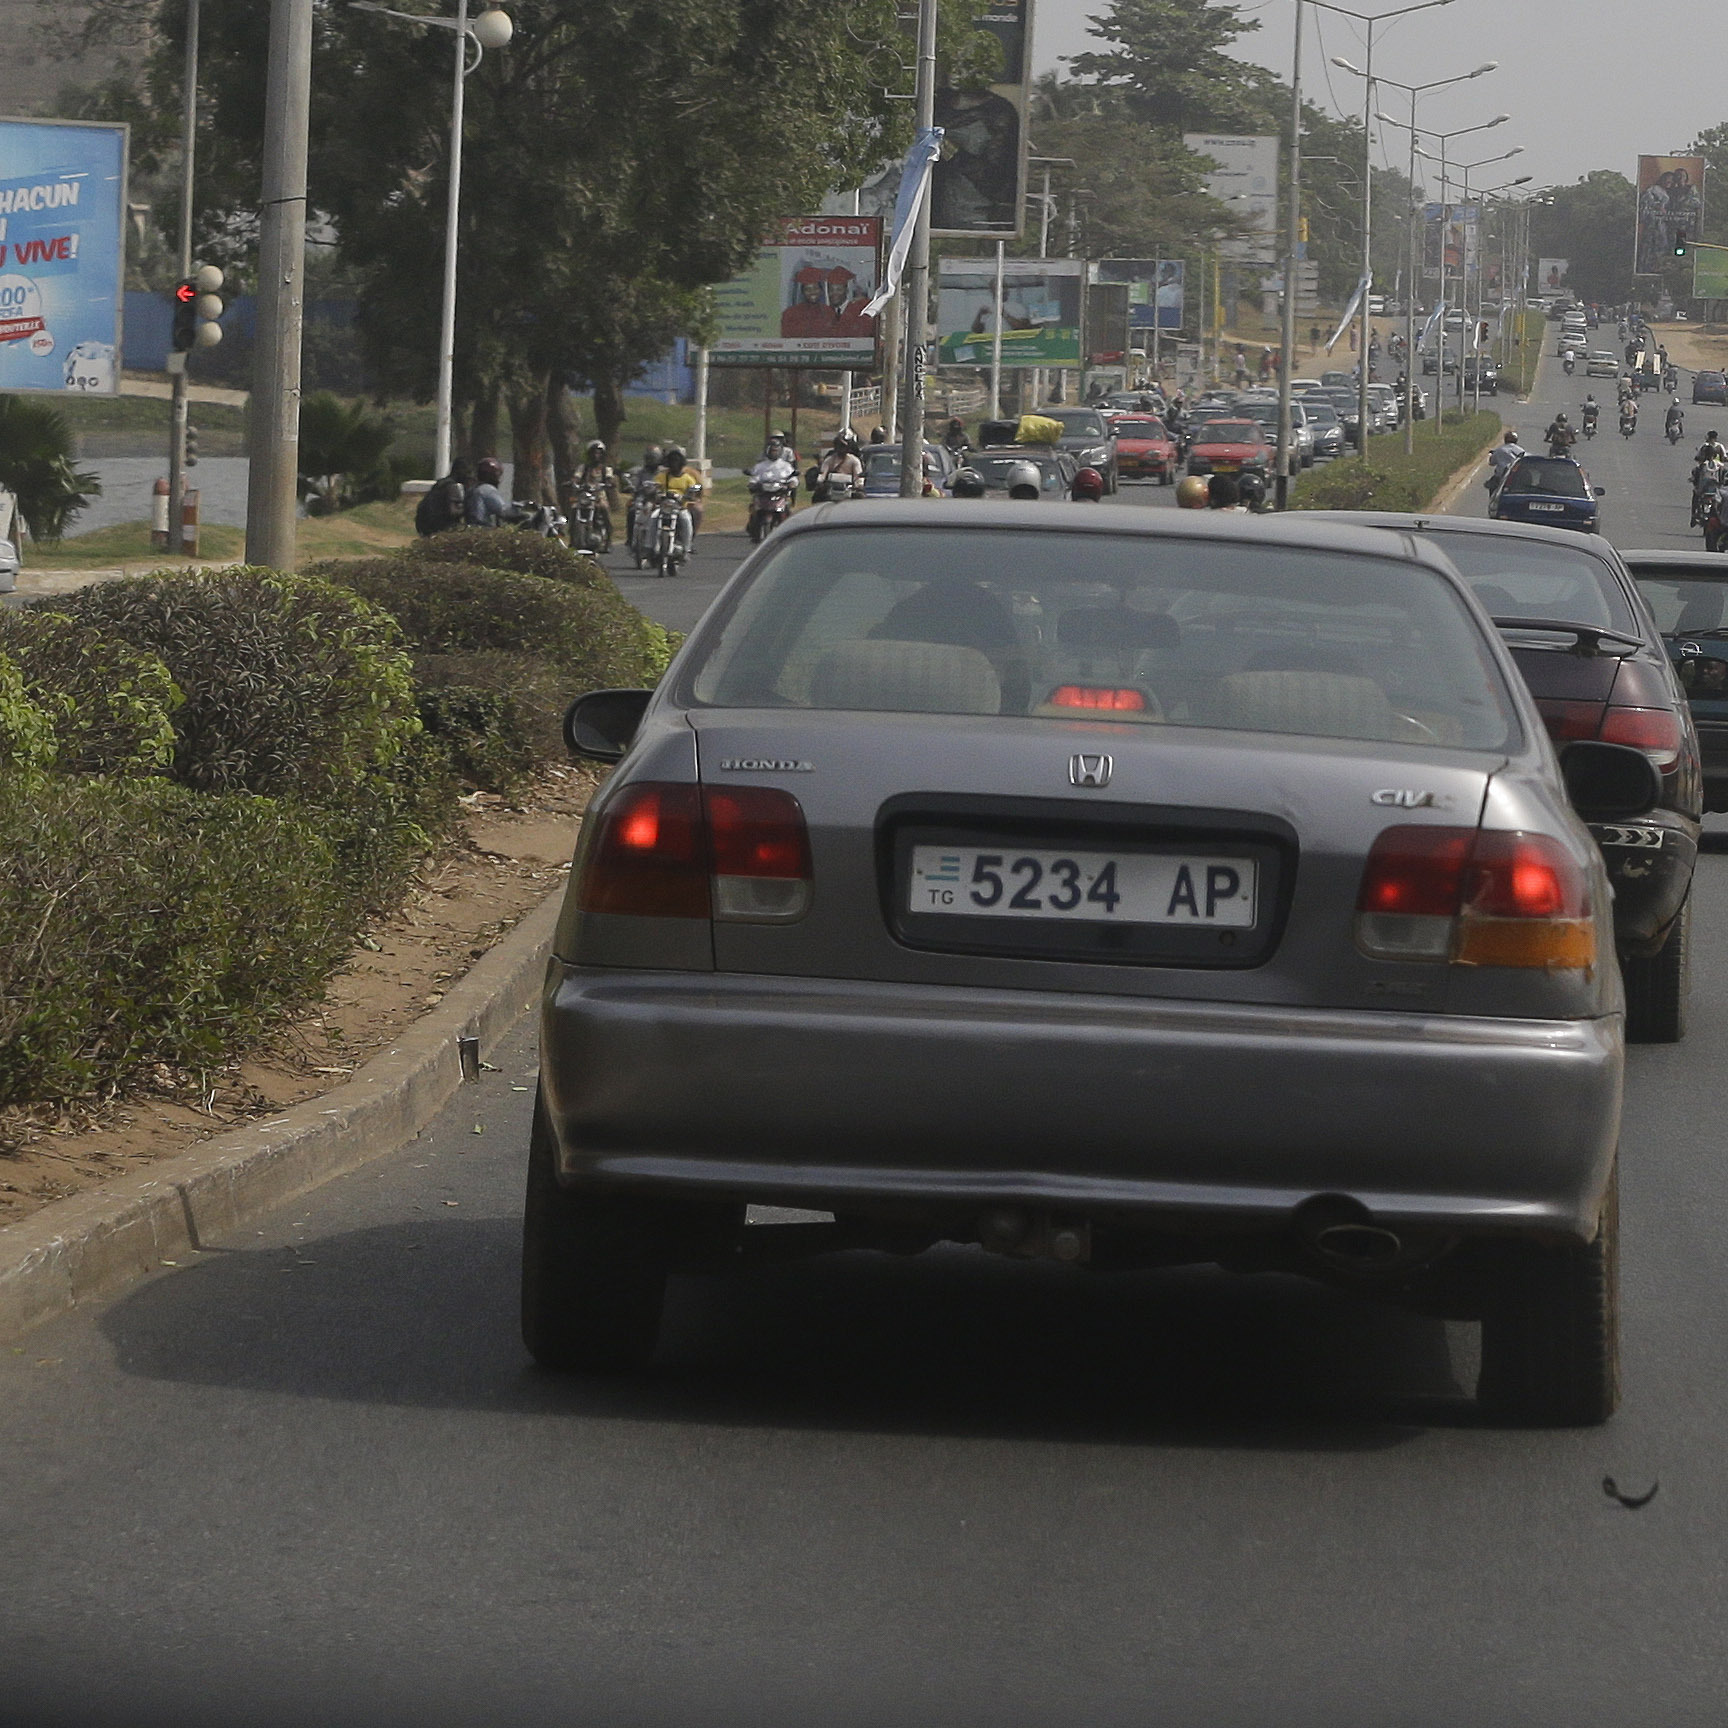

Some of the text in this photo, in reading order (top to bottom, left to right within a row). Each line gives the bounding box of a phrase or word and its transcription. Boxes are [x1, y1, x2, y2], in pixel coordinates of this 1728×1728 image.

[0, 182, 80, 214] HACUN
[14, 233, 80, 265] VIVE!
[721, 759, 816, 771] HONDA
[929, 855, 1240, 917] TG 5234 AP
